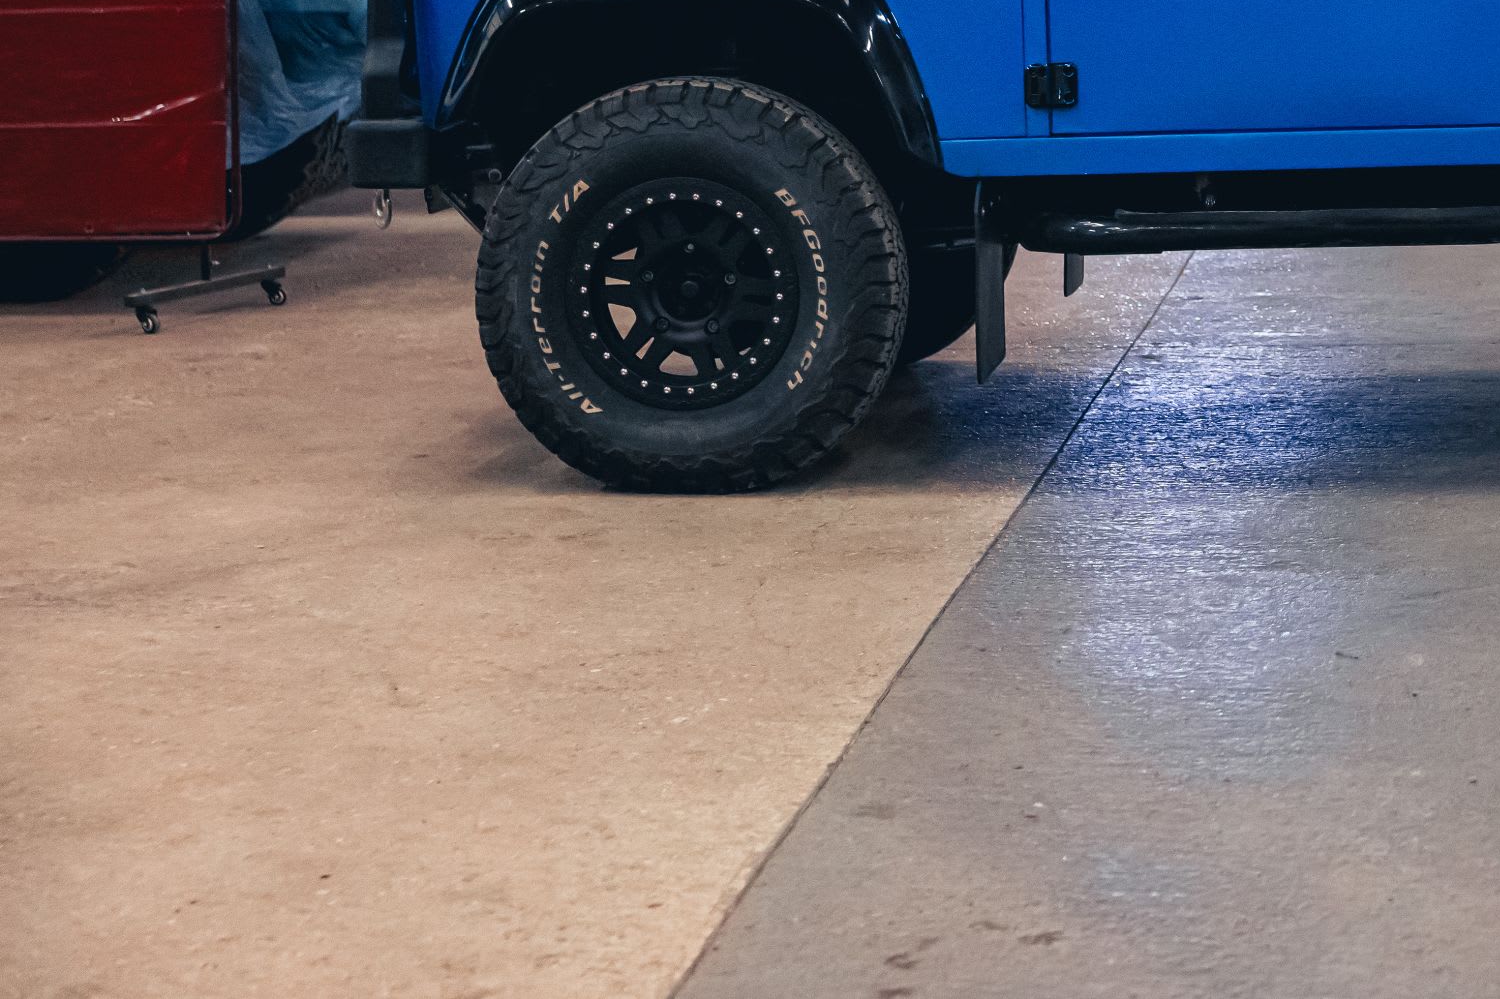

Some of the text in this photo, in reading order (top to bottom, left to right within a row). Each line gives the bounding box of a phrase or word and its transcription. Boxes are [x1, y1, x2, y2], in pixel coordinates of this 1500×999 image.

[531, 180, 603, 414] All-Terrain T/A
[774, 188, 829, 390] BFGoodrich
